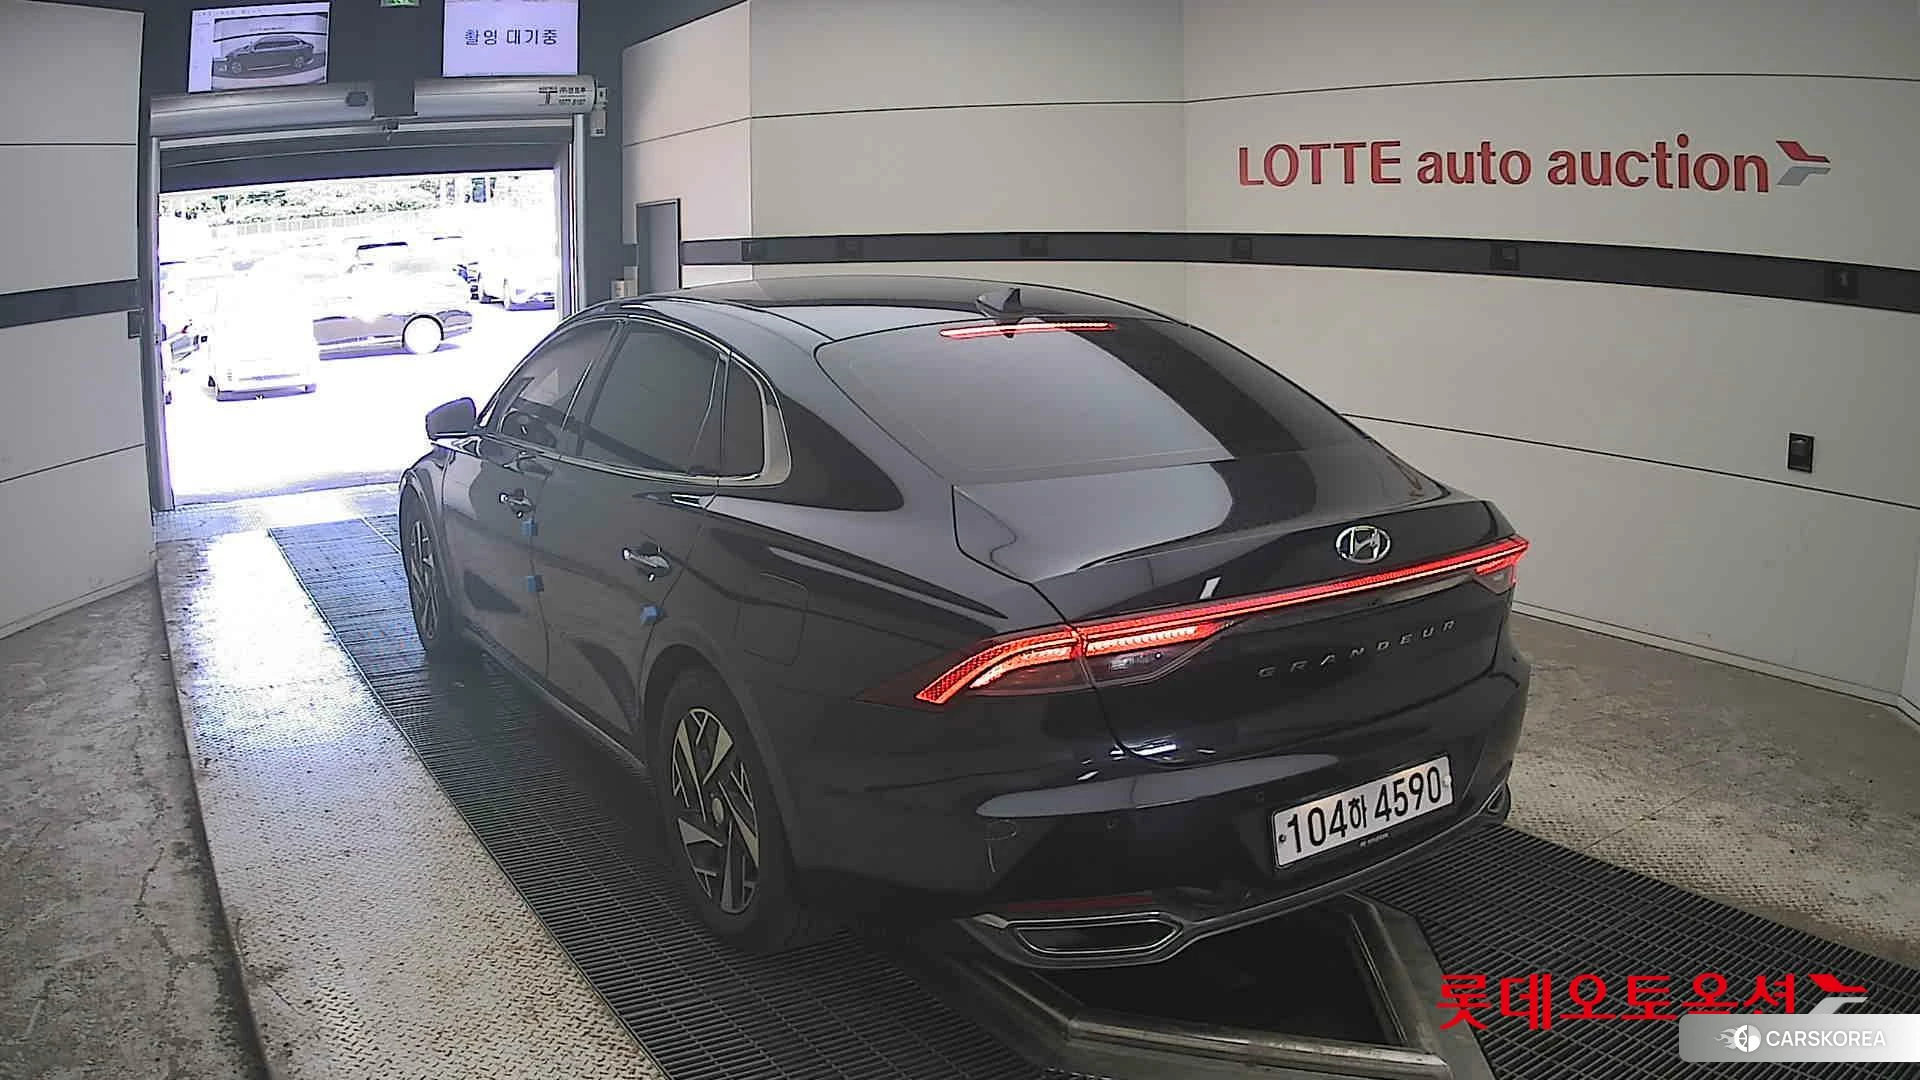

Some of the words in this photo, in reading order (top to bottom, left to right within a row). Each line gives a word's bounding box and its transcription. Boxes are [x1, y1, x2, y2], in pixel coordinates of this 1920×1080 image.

[506, 28, 558, 46] 대기중
[1239, 140, 1402, 187] LOTTE
[1416, 141, 1532, 185] auto
[1547, 133, 1769, 193] auction
[1258, 619, 1455, 678] GRANDEUR
[1287, 794, 1368, 853] 104하
[1374, 766, 1442, 822] 4590
